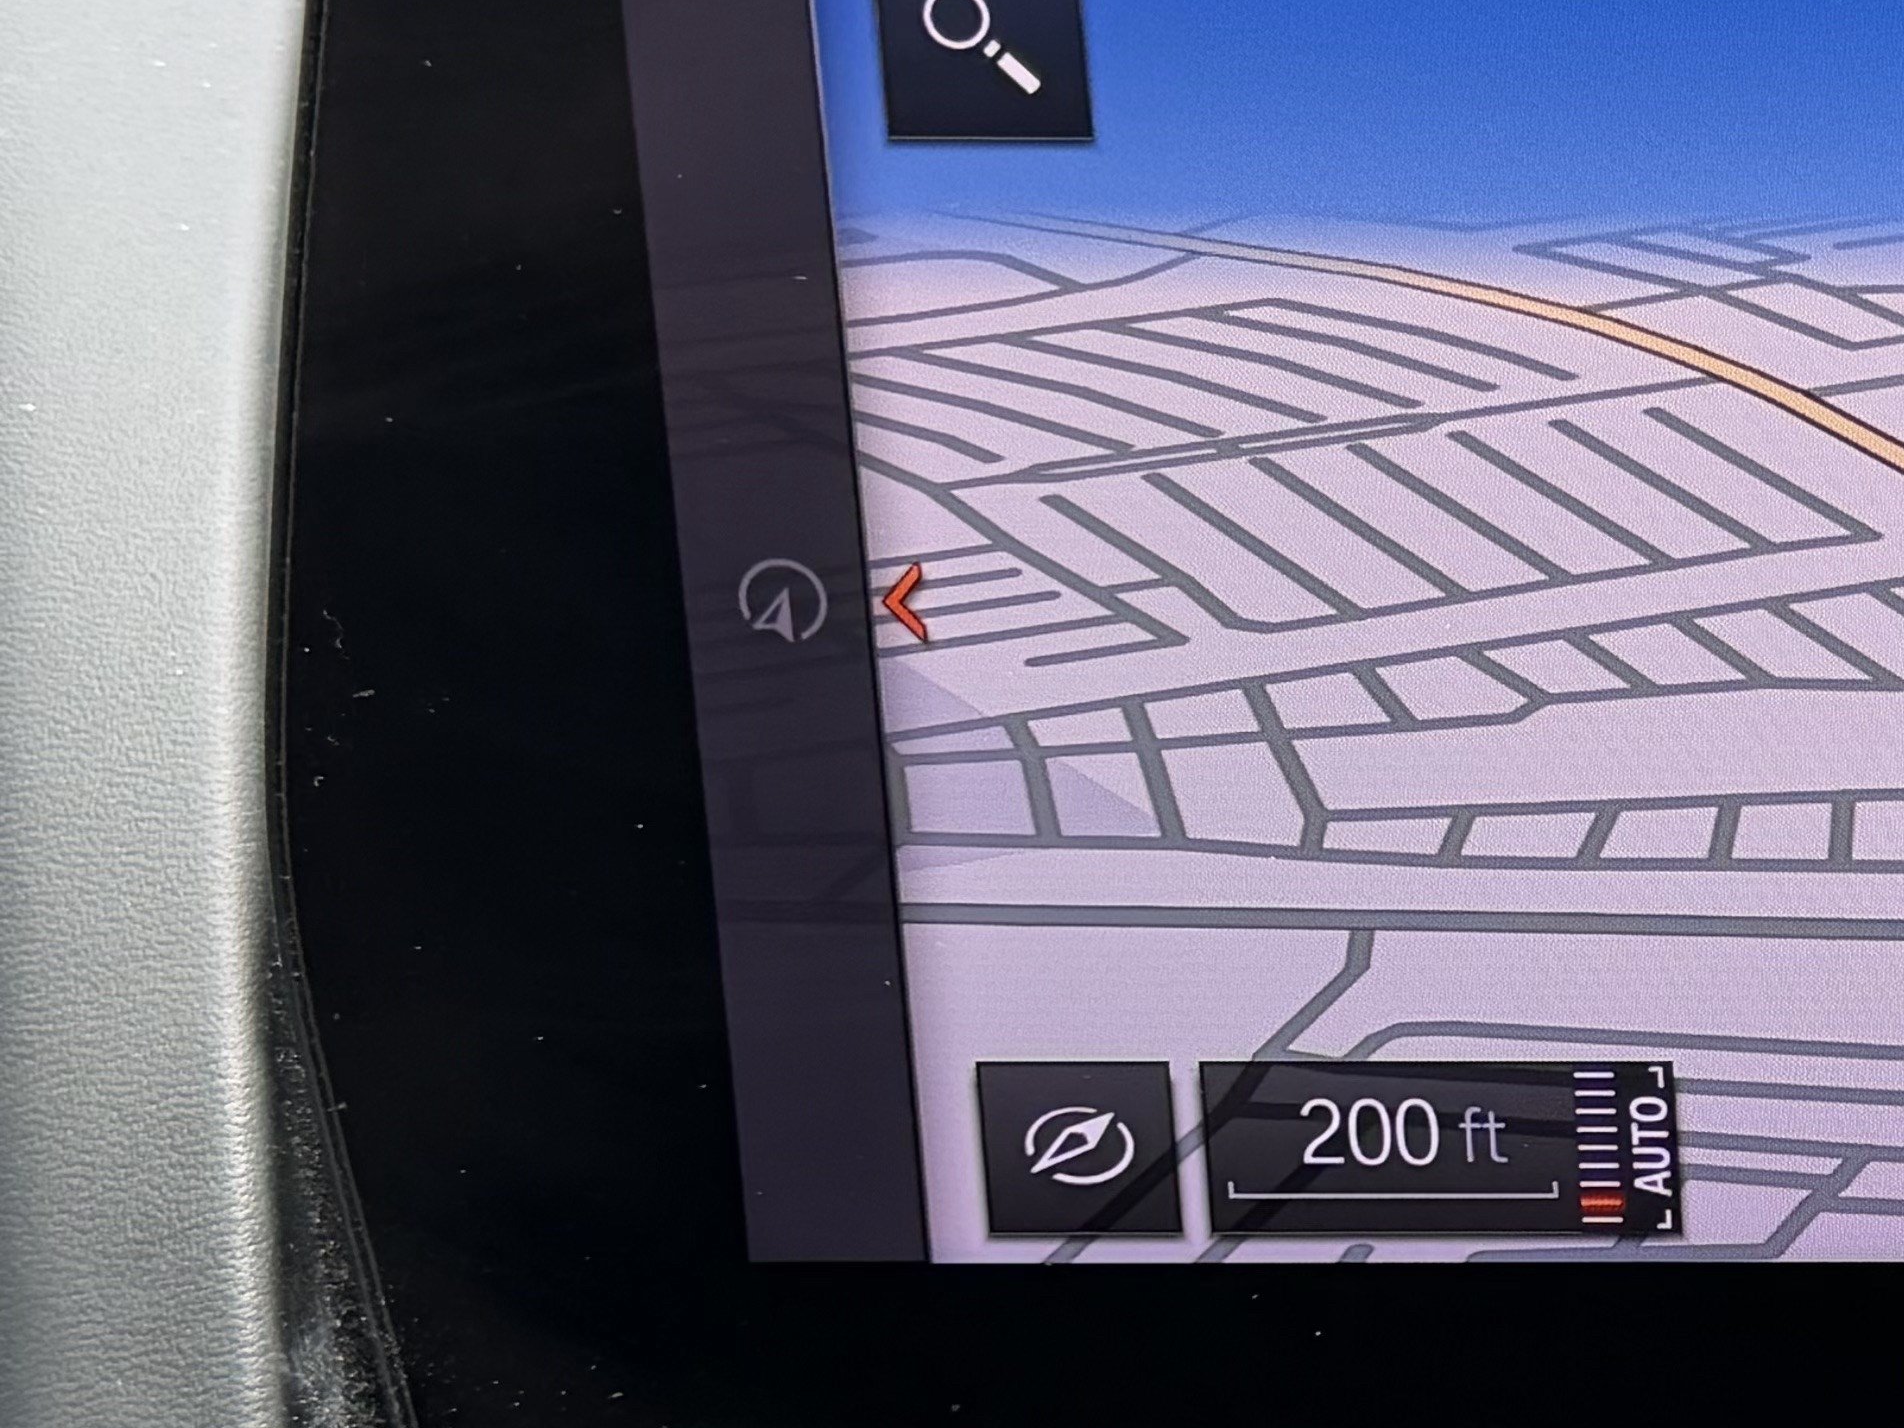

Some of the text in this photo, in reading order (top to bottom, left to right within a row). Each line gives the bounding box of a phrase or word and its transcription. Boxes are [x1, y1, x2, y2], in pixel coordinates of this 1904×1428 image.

[1300, 1097, 1509, 1167] 200 ft
[1630, 1096, 1670, 1197] AUTO
